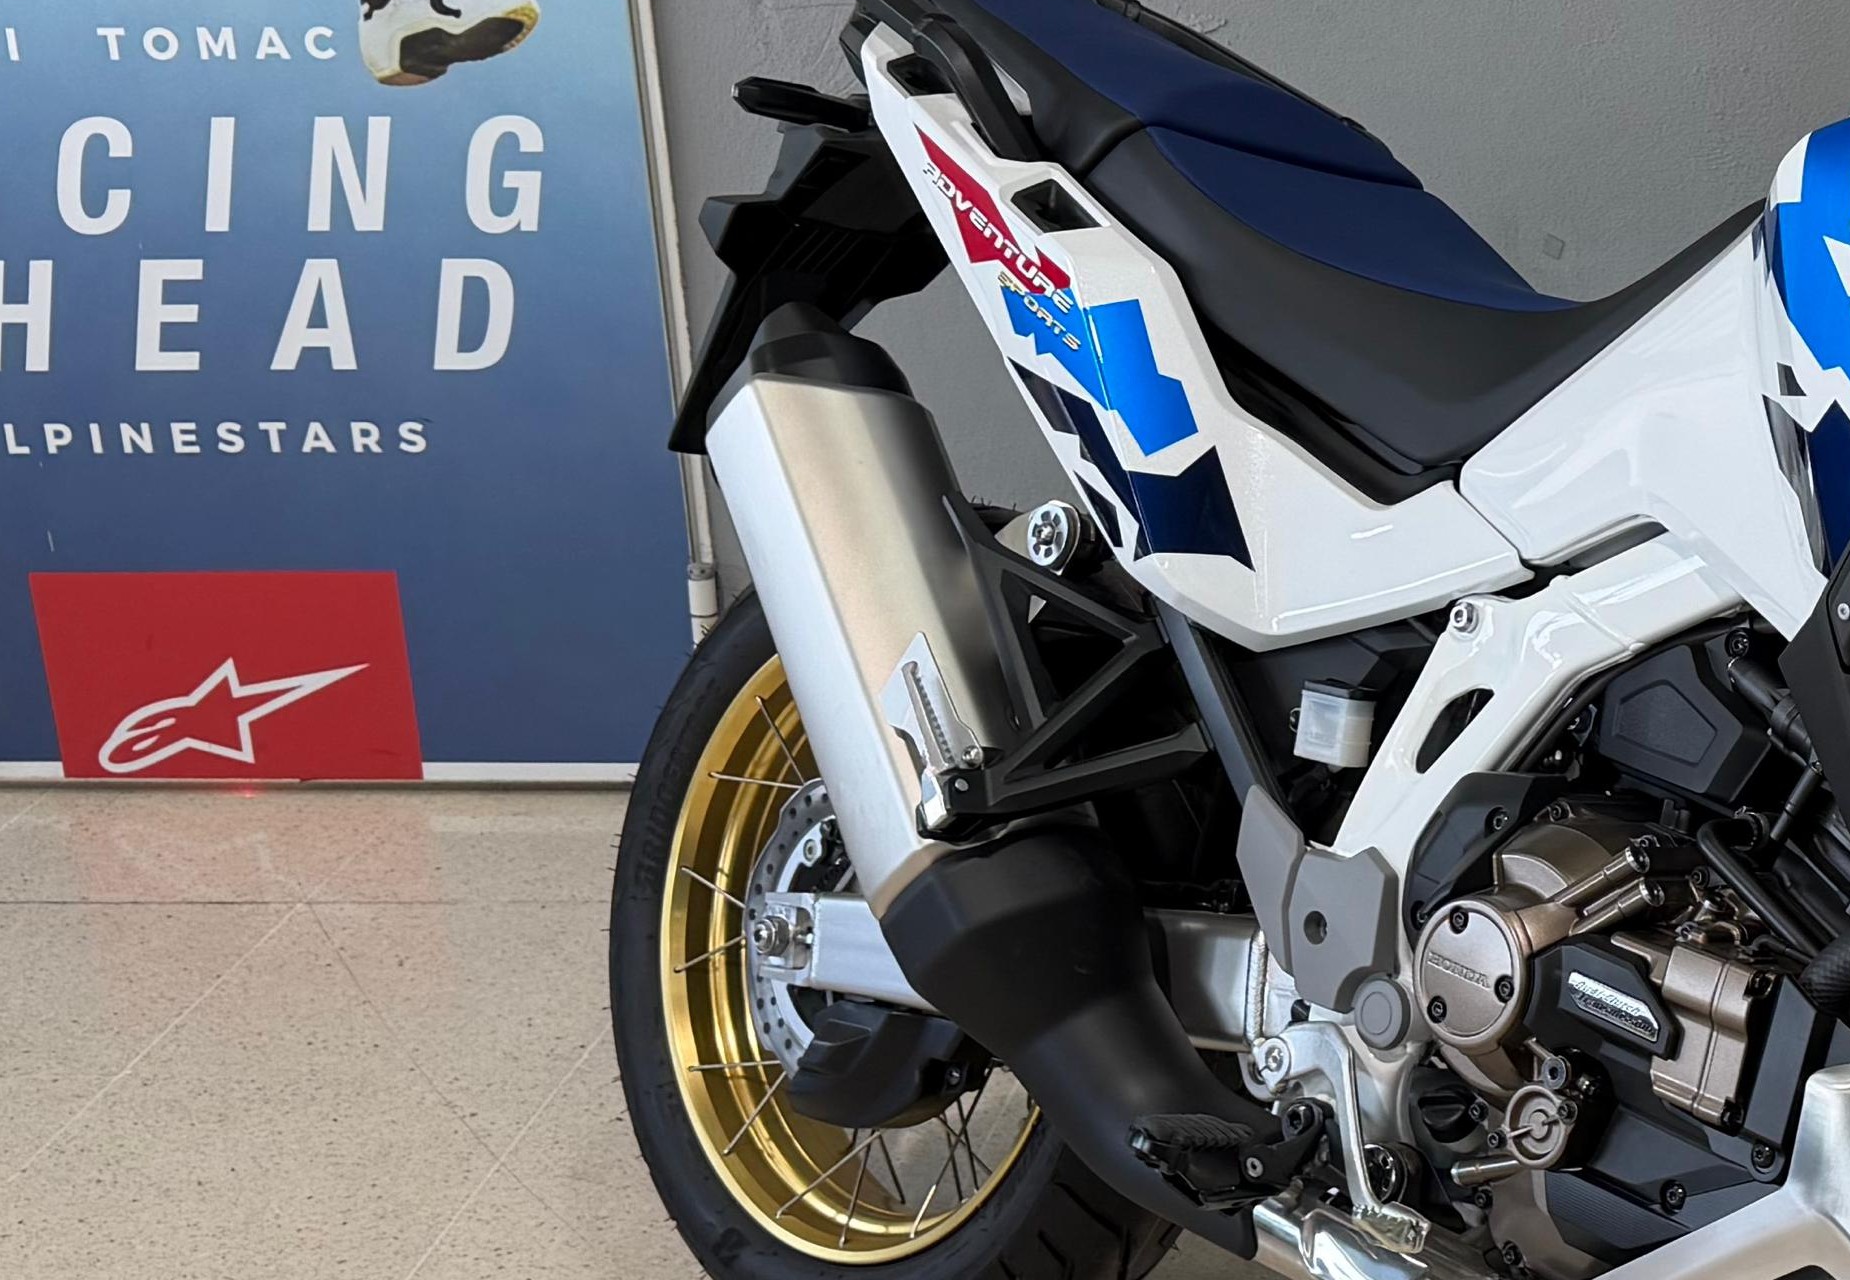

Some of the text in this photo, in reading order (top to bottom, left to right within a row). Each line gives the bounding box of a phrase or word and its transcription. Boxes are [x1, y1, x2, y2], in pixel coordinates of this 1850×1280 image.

[96, 26, 338, 62] TOMAC
[57, 115, 546, 236] CING
[922, 162, 1074, 314] ADVENTURE
[0, 258, 517, 372] HEAD
[997, 271, 1081, 351] SPORTS
[3, 422, 428, 455] LPINESTARS
